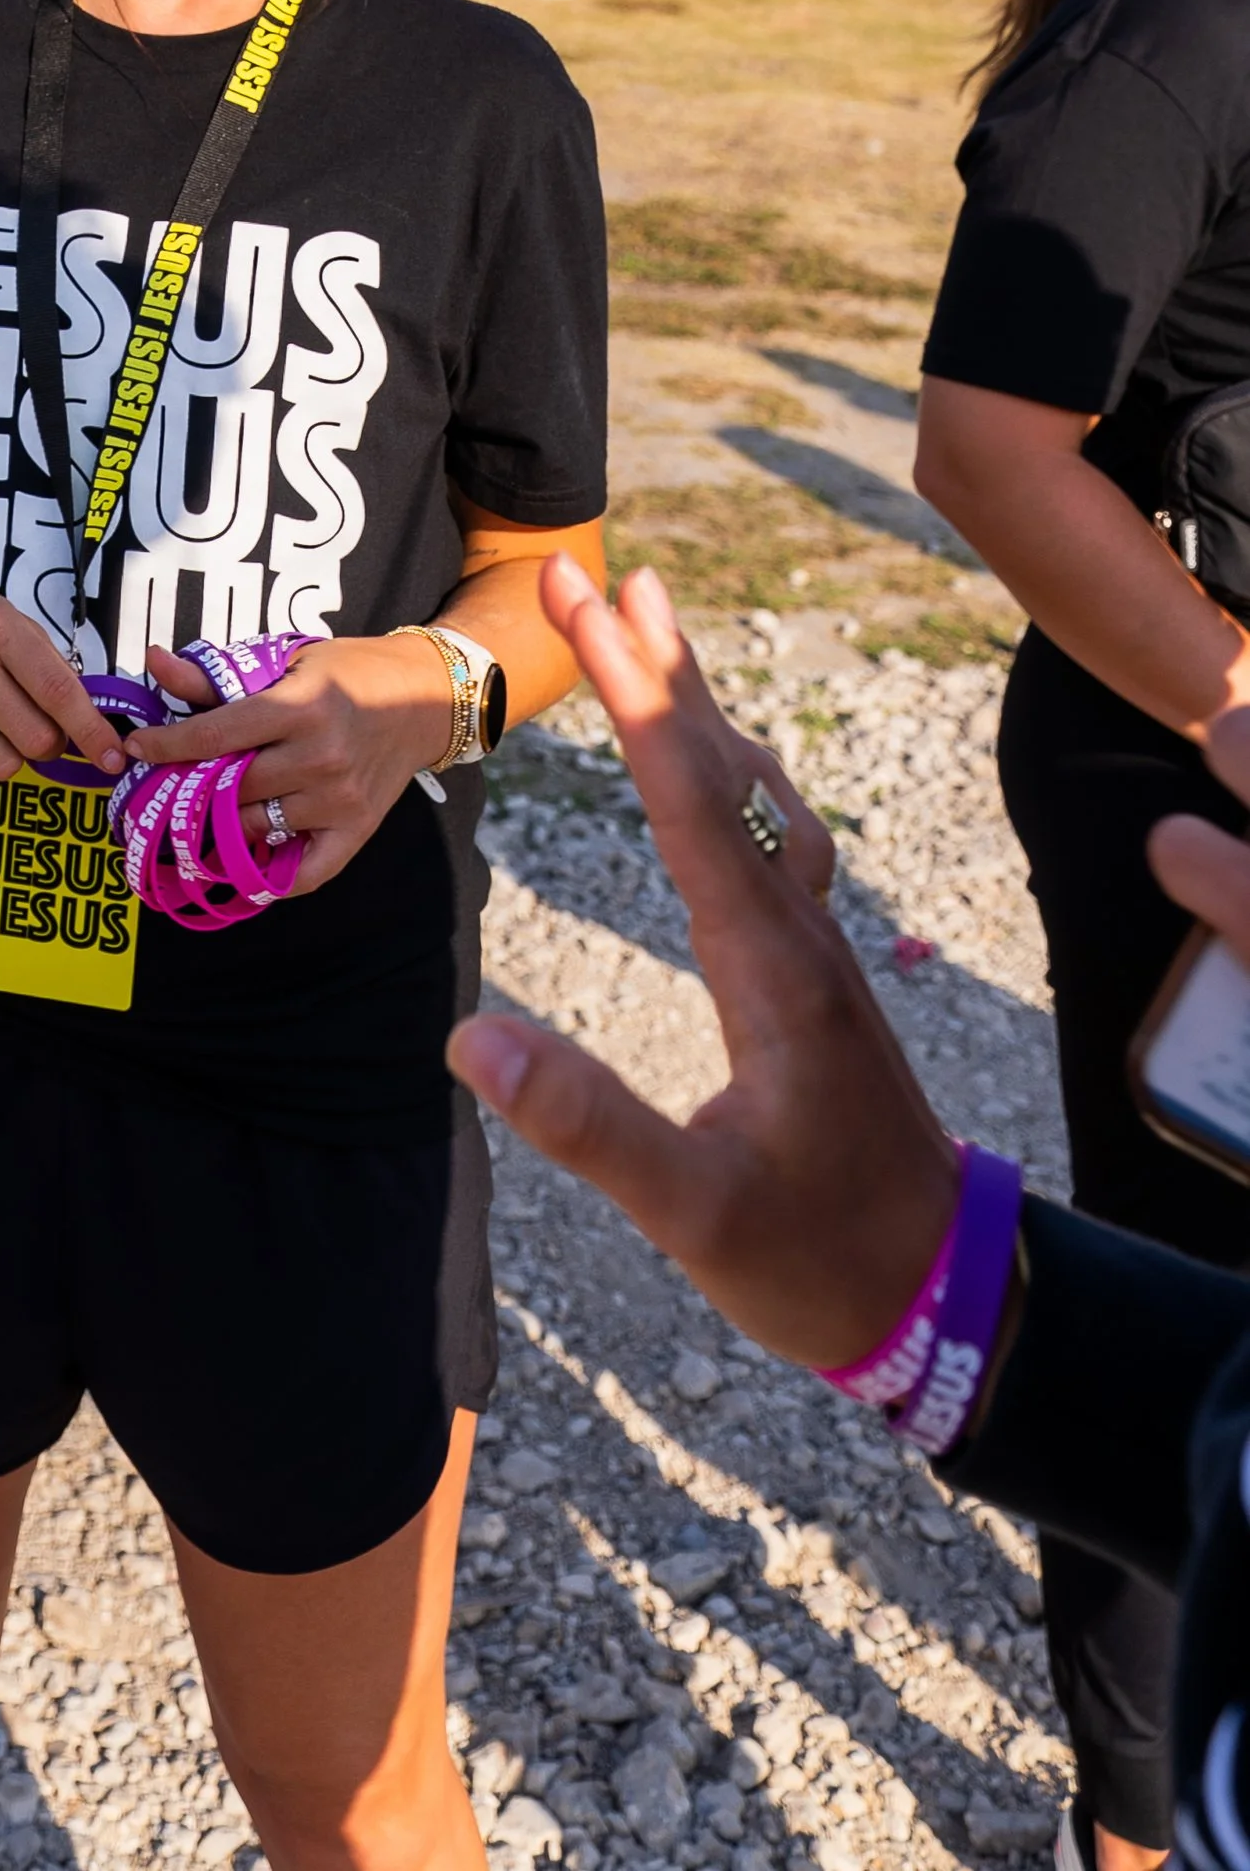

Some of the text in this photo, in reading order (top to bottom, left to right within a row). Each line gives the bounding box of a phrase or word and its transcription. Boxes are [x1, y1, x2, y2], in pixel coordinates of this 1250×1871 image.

[224, 15, 291, 114] JESUS!
[84, 221, 203, 542] JESUS! JESUS! JESUS!
[170, 771, 205, 832] JESUS
